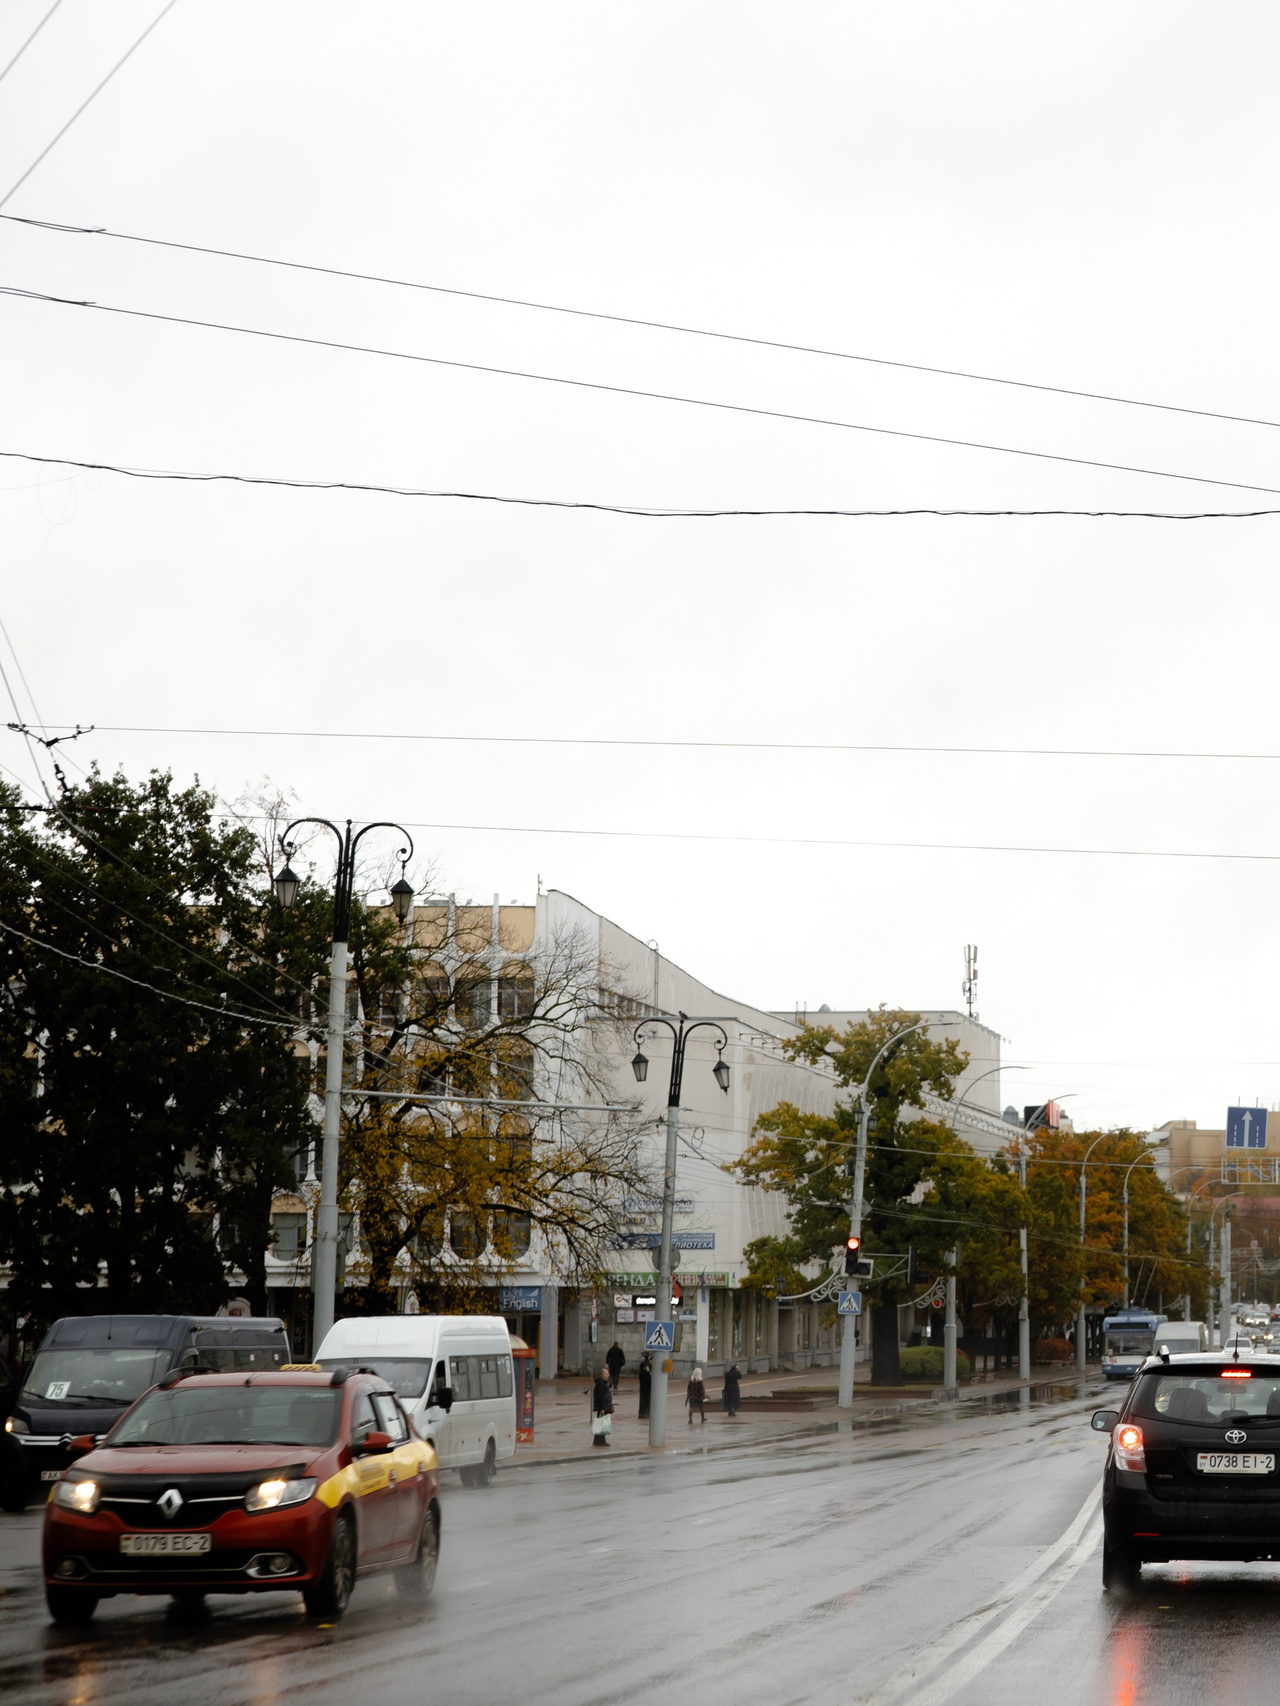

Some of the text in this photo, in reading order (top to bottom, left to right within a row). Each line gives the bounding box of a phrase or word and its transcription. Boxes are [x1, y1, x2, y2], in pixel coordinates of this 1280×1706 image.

[503, 1298, 538, 1310] English
[49, 1383, 65, 1398] 75
[1209, 1455, 1238, 1468] 0738
[1242, 1455, 1273, 1469] EI-2
[134, 1535, 209, 1551] 0179 EC-2
